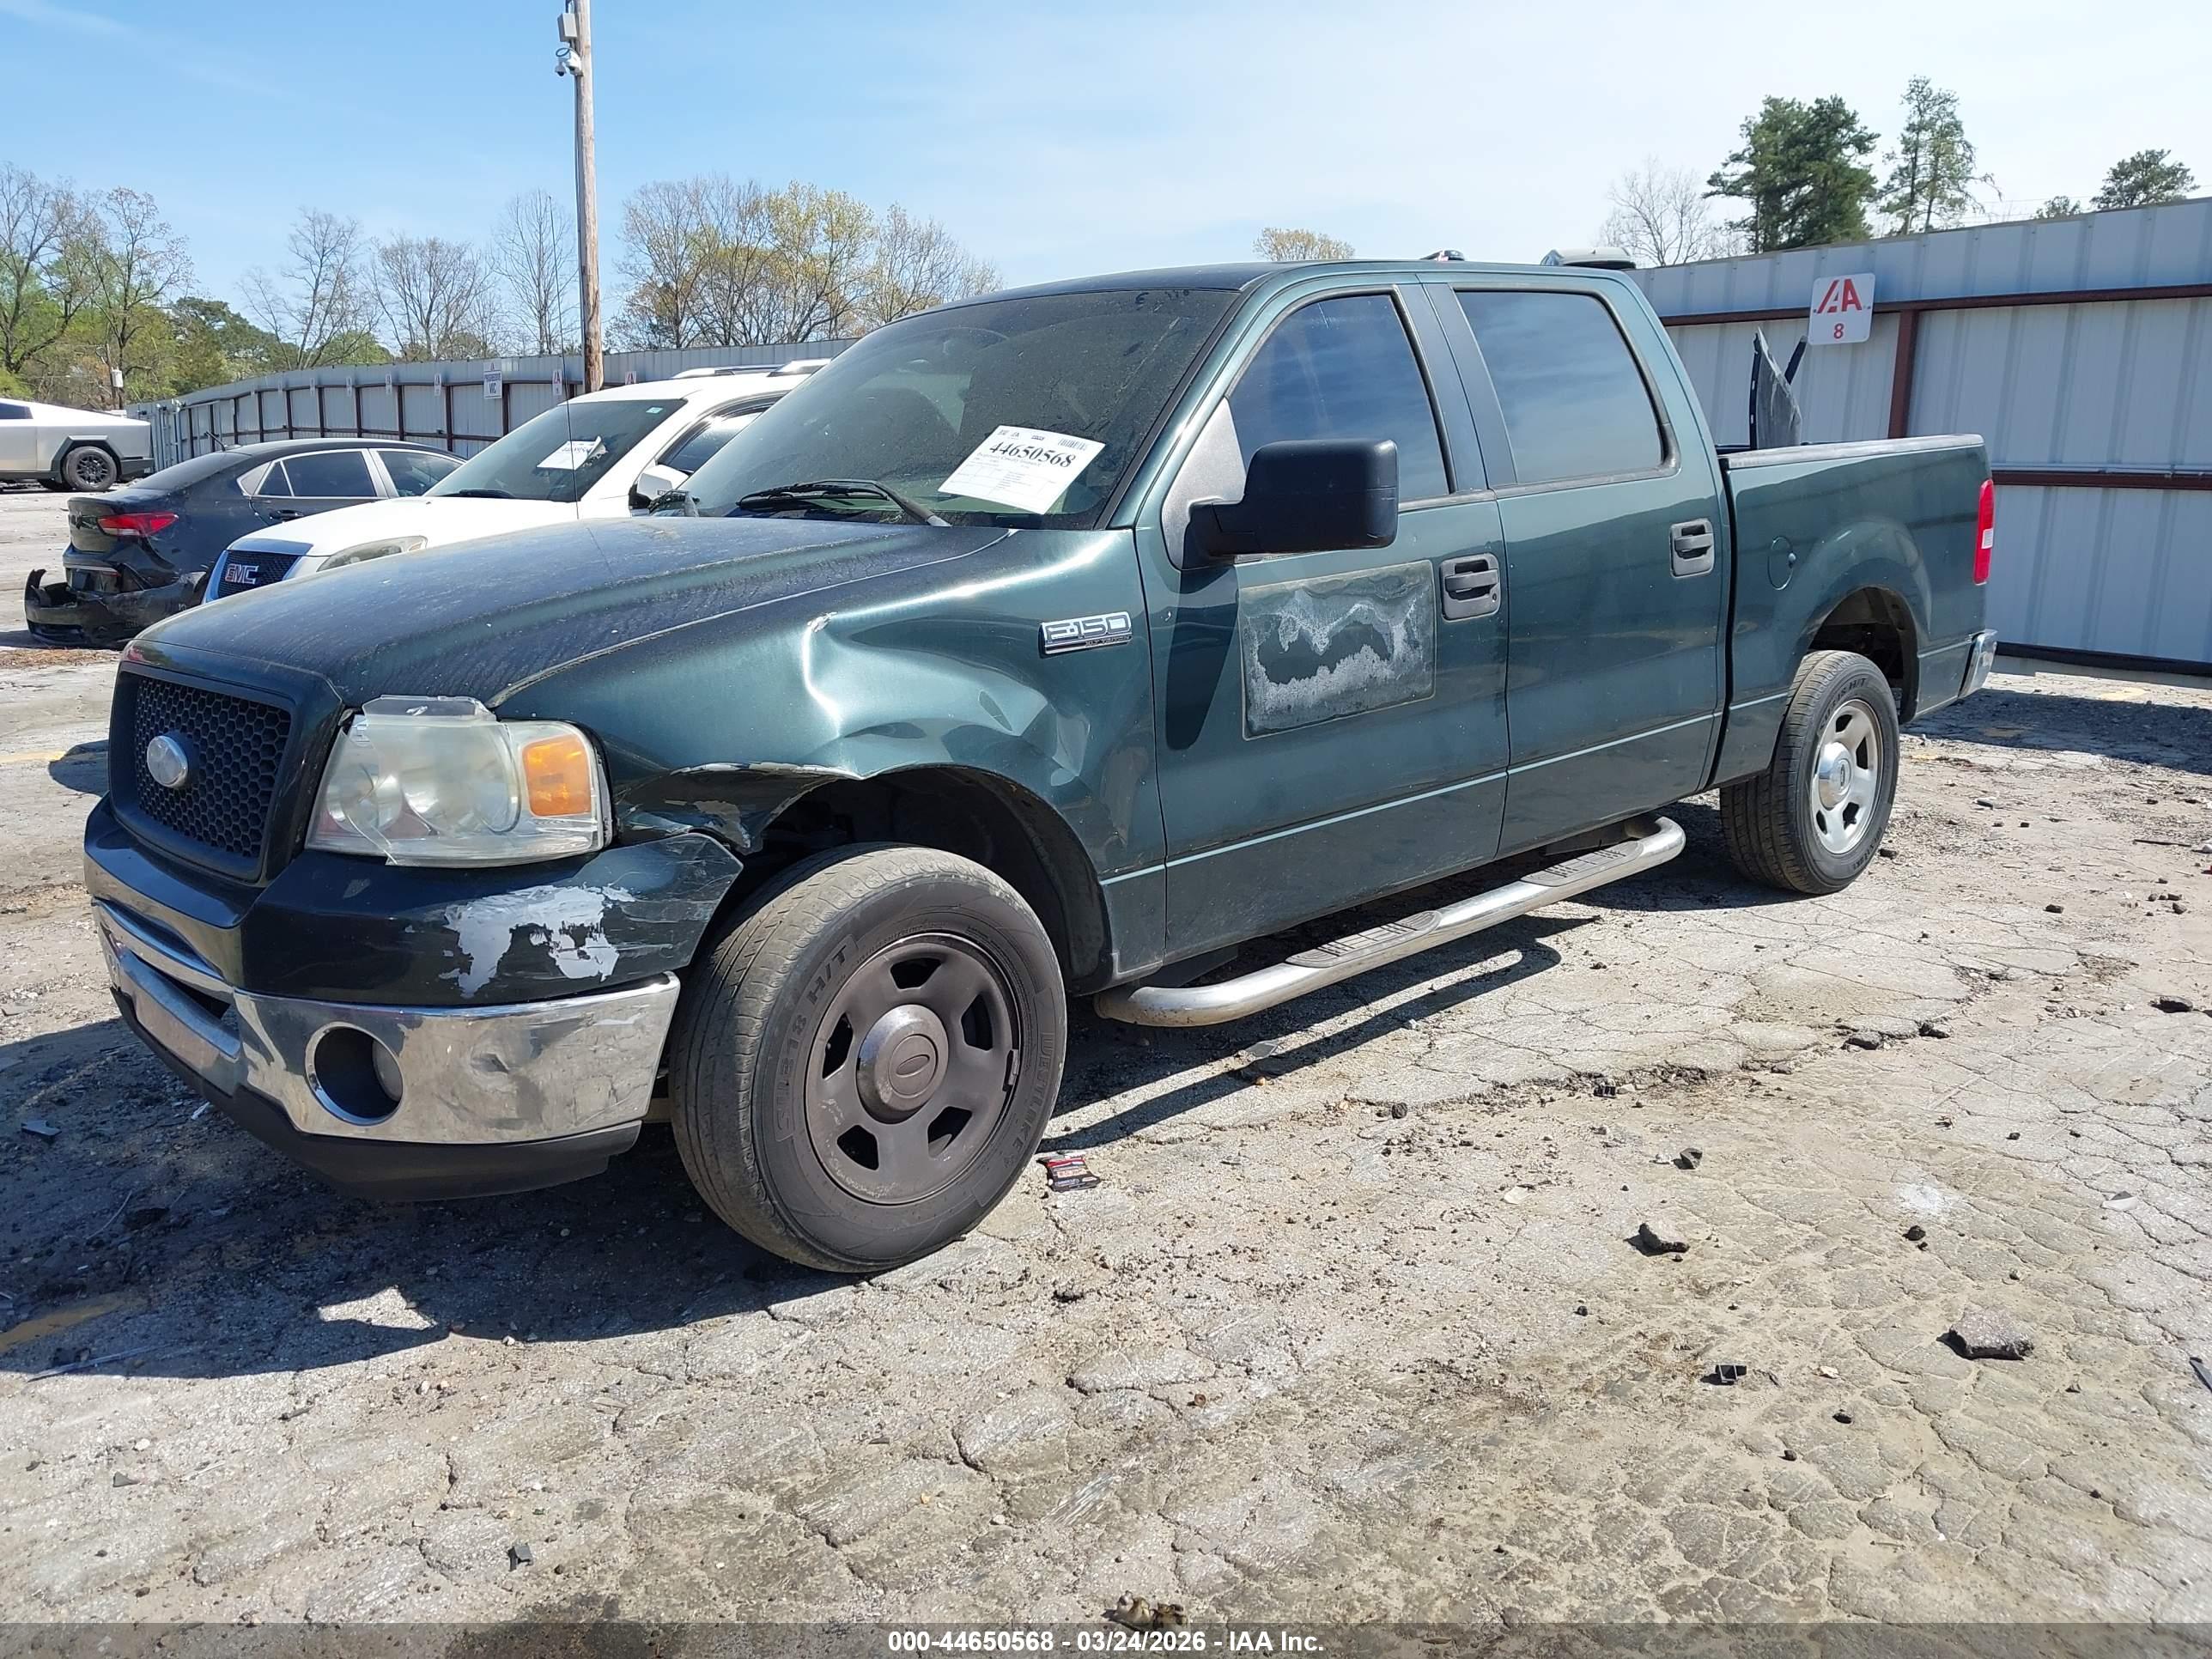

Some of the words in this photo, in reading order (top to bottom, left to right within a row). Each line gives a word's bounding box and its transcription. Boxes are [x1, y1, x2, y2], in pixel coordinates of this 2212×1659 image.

[1833, 322, 1844, 339] 8
[989, 441, 1077, 468] 44650568
[225, 563, 259, 584] GMC
